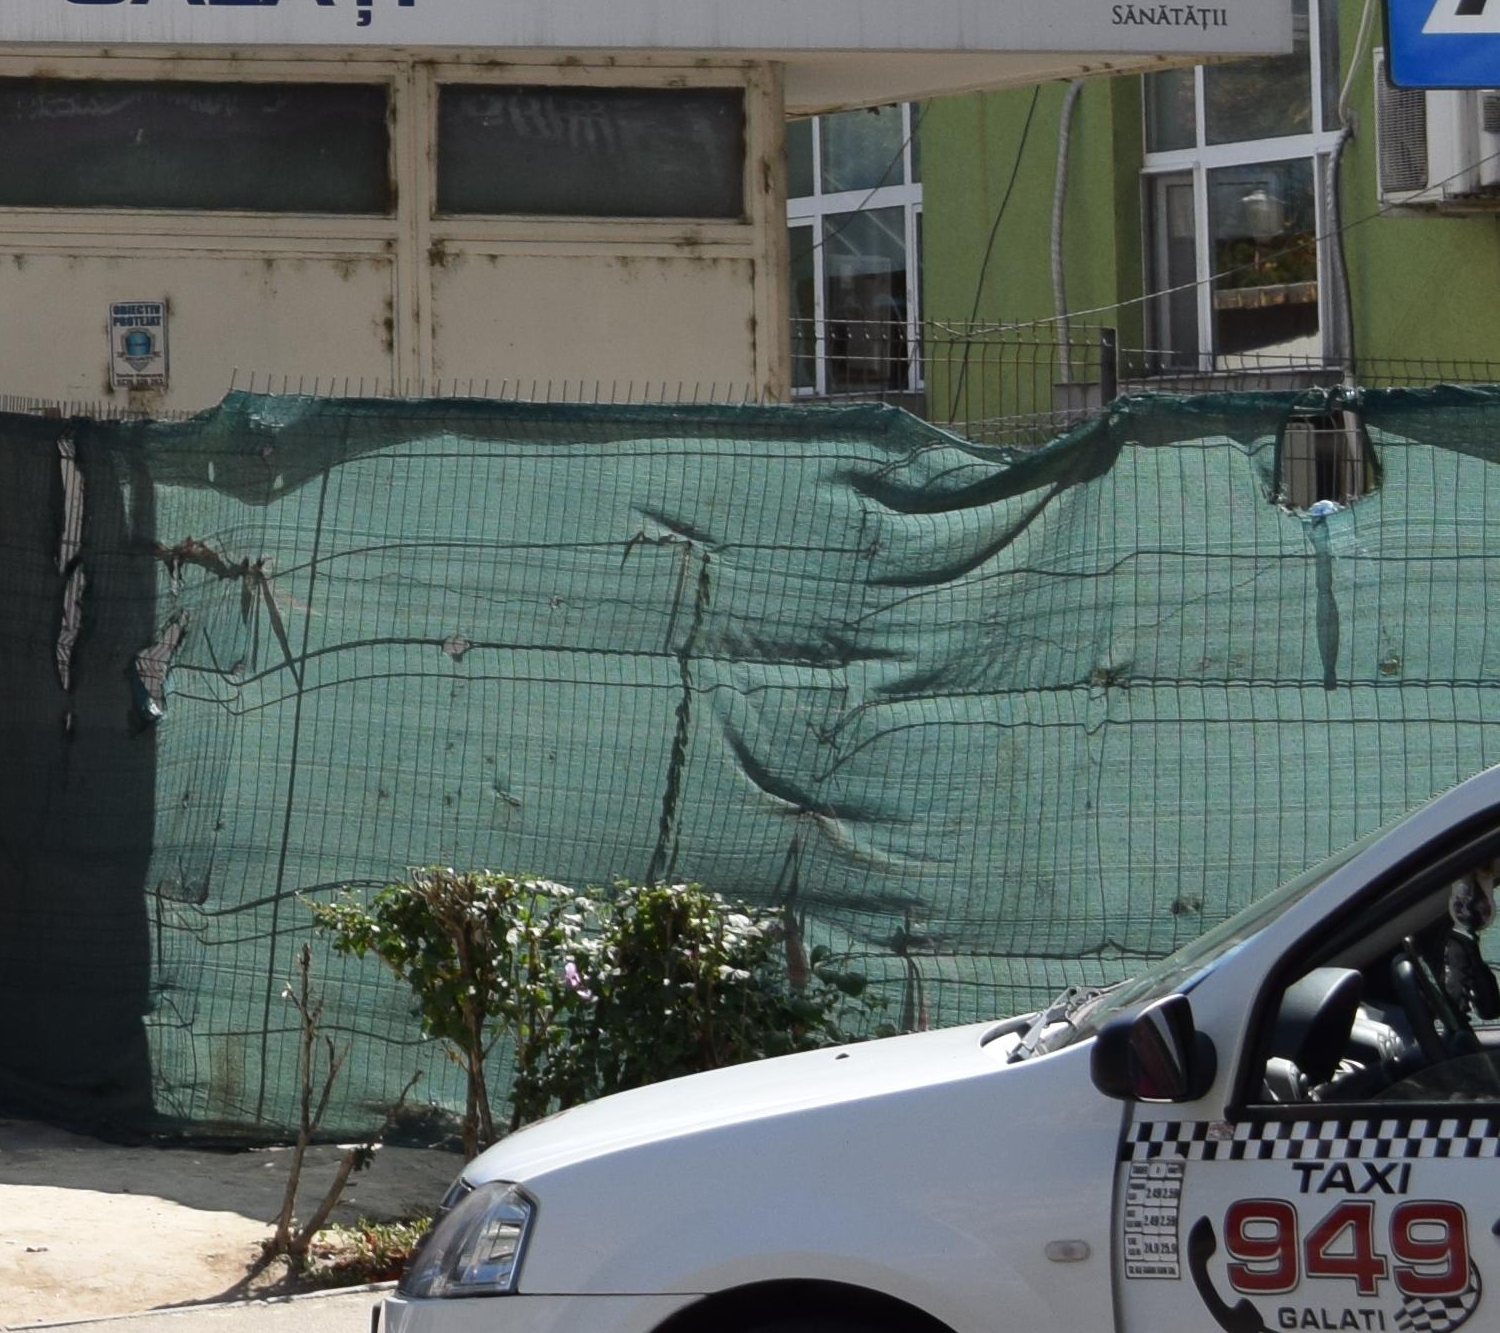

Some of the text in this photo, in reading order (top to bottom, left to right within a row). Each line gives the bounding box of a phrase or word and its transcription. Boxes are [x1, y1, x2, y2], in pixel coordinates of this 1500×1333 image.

[1291, 1162, 1412, 1194] TAXI
[1224, 1198, 1471, 1297] 949
[1277, 1307, 1386, 1331] GALATI
